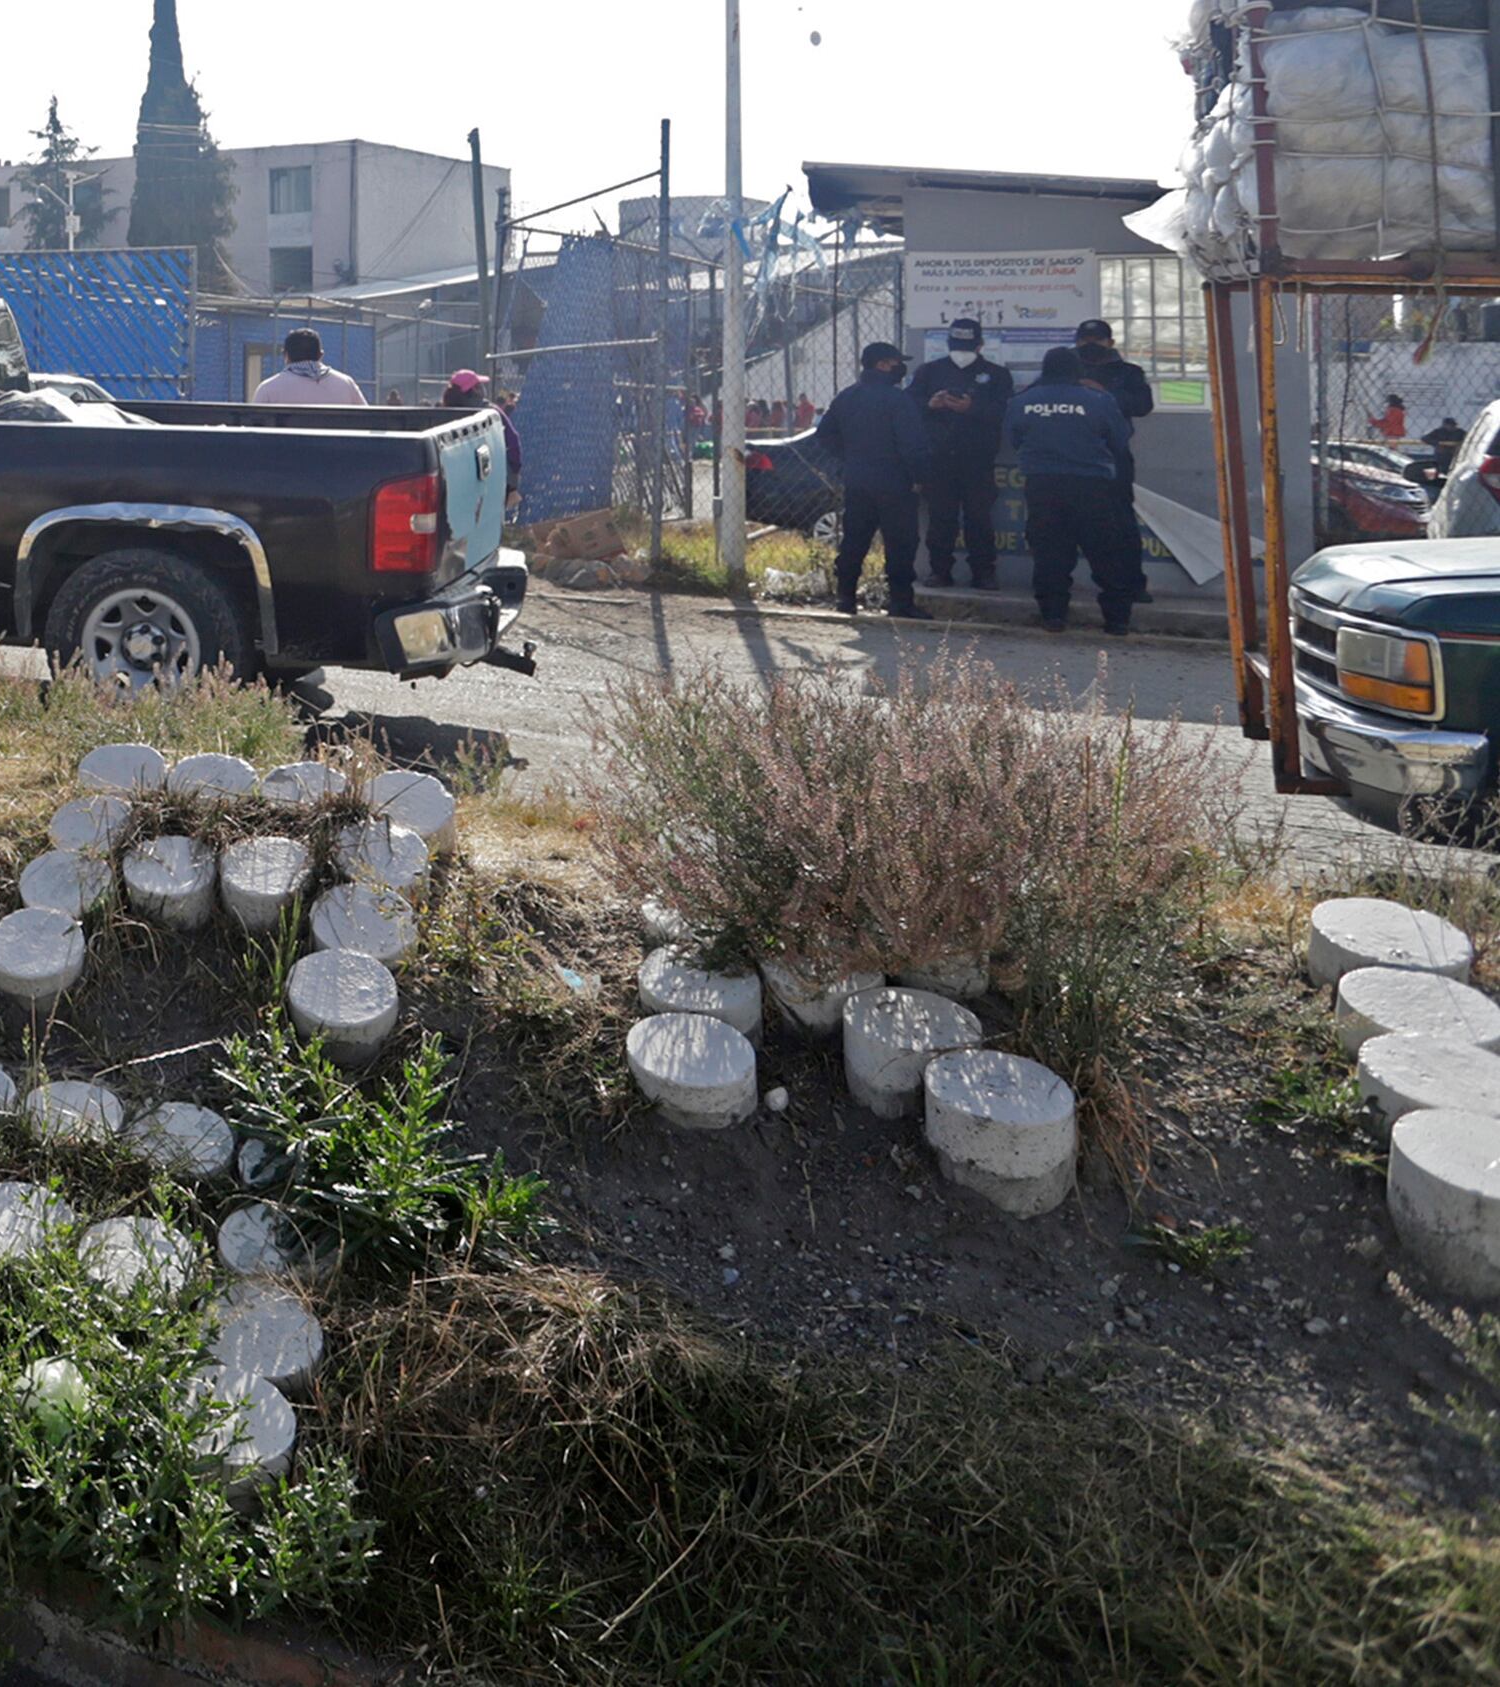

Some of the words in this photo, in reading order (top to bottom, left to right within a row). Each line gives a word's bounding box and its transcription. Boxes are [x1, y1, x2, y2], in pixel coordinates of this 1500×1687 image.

[914, 258, 951, 267] AHORA
[953, 258, 971, 267] TUS
[1033, 257, 1045, 266] DE
[1049, 256, 1084, 266] SALDO
[914, 283, 941, 292] Entra
[1024, 403, 1086, 416] POLICIA
